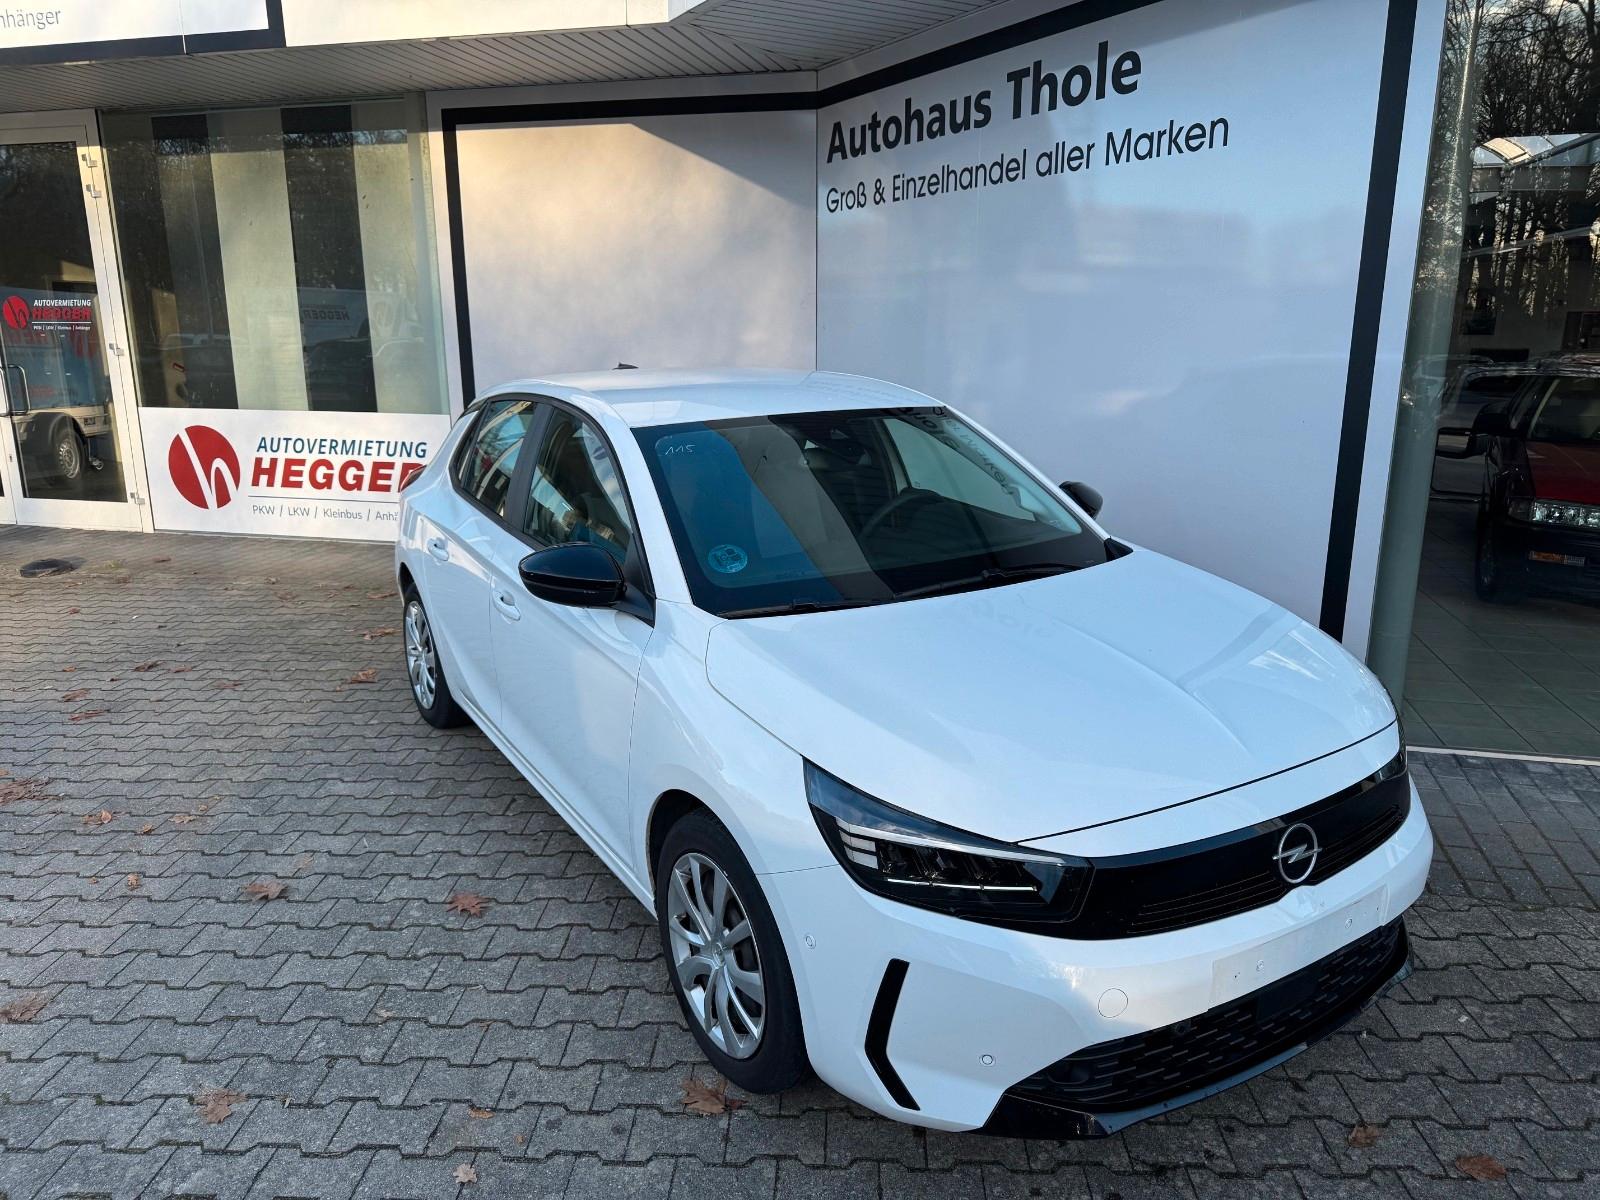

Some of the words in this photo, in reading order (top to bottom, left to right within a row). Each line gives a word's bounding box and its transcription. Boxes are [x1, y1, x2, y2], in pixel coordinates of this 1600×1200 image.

[826, 90, 992, 164] Autohaus
[1006, 40, 1142, 120] Thole
[826, 181, 867, 213] Groß
[873, 178, 886, 204] &
[892, 148, 1027, 202] Einzelhandel
[1035, 141, 1096, 176] aller
[1105, 117, 1229, 166] Marken
[33, 299, 92, 307] AUTOVERMIETUNG
[257, 436, 428, 459] AUTOVERMIETUNG
[665, 444, 696, 455] 115
[252, 504, 275, 516] PKW
[288, 505, 310, 517] LKW
[323, 508, 363, 520] Kleinbus
